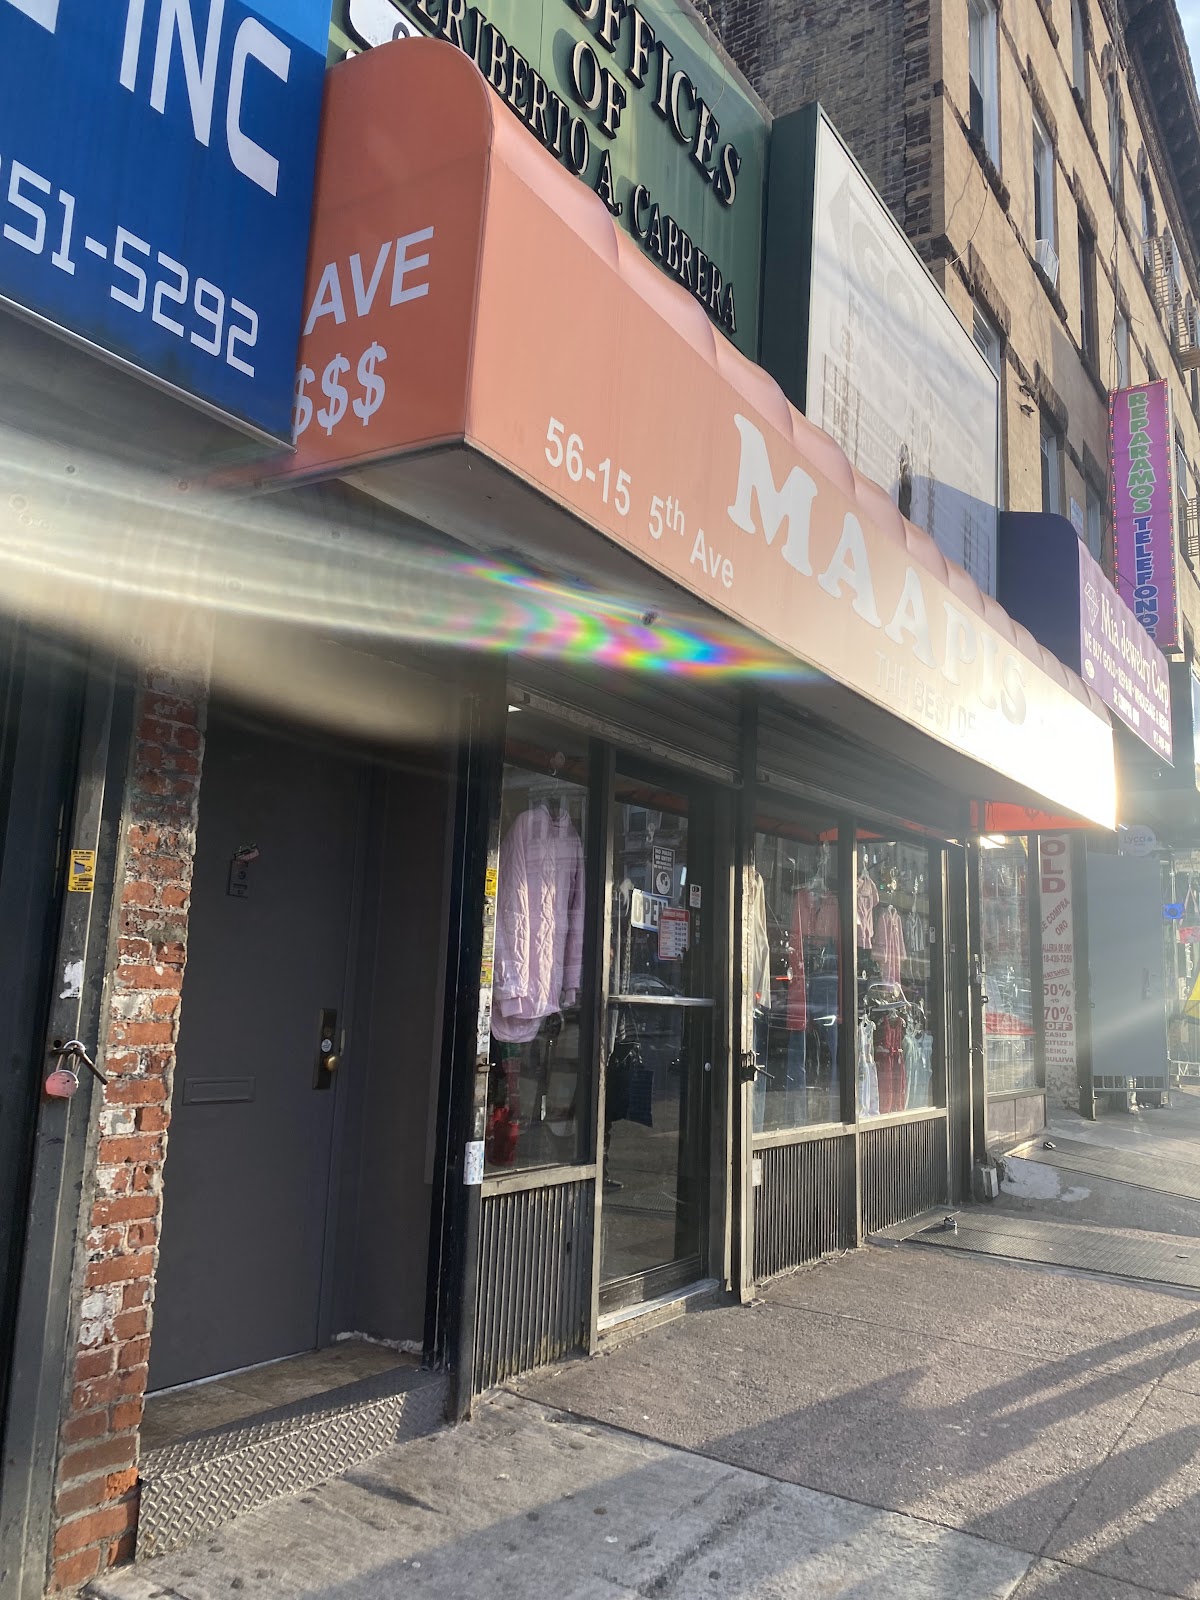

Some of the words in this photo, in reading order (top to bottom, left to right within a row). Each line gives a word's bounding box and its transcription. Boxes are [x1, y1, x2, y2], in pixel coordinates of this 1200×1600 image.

[119, 0, 292, 197] INC
[571, 39, 627, 139] OF
[0, 154, 260, 378] 51-5292
[632, 184, 738, 334] CABRERA
[544, 416, 632, 516] 56-15
[649, 495, 685, 539] 5th
[689, 528, 735, 589] Ave
[1127, 391, 1157, 514] REPARAMOS
[727, 413, 1028, 725] MAAPIS
[1101, 592, 1120, 653] Mia
[1121, 619, 1151, 694] Jewelry
[1152, 658, 1169, 714] Corp
[1040, 834, 1066, 893] OLD
[1046, 897, 1071, 925] COMPRA
[1055, 919, 1069, 936] ORO
[1044, 1006, 1073, 1021] 70%
[1046, 1022, 1070, 1030] OFF
